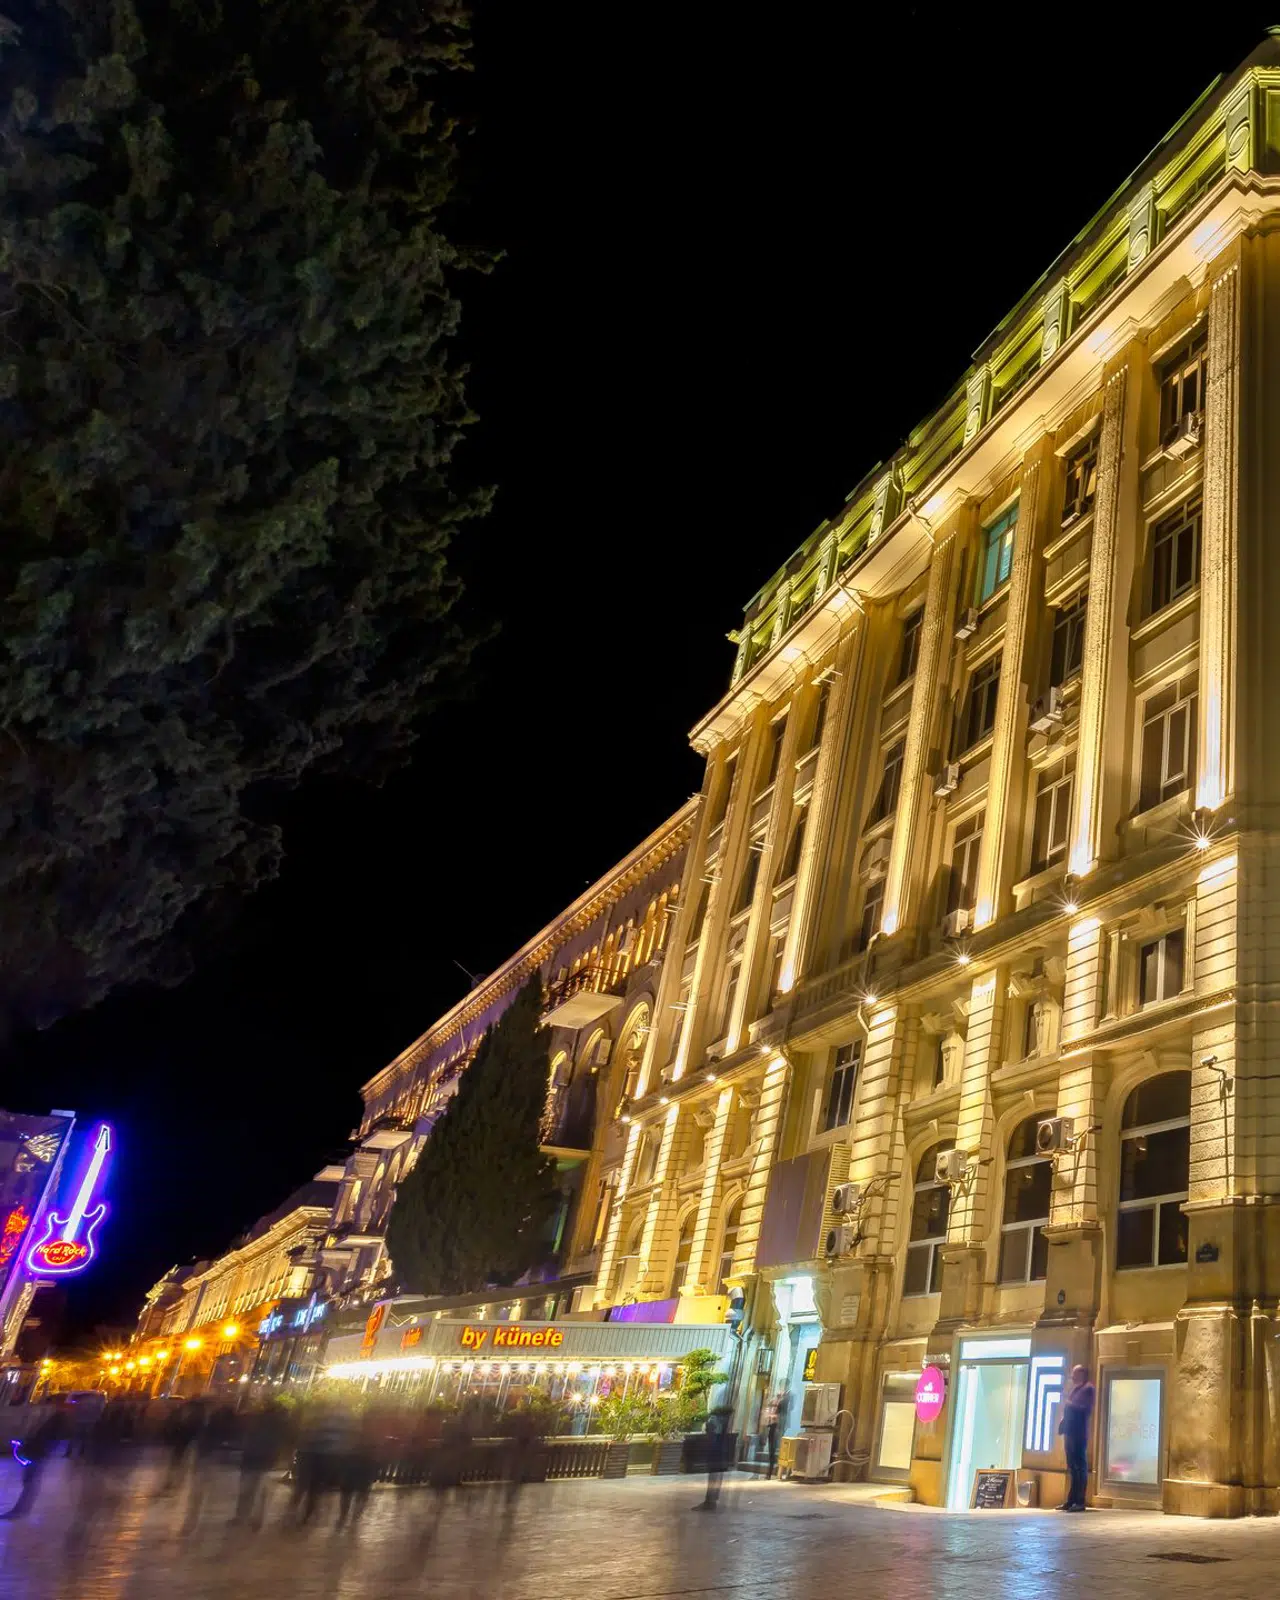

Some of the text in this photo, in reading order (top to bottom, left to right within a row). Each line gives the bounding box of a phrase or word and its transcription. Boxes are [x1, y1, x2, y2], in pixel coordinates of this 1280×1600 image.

[36, 1245, 86, 1257] Hard Rock
[461, 1325, 565, 1350] by künefe
